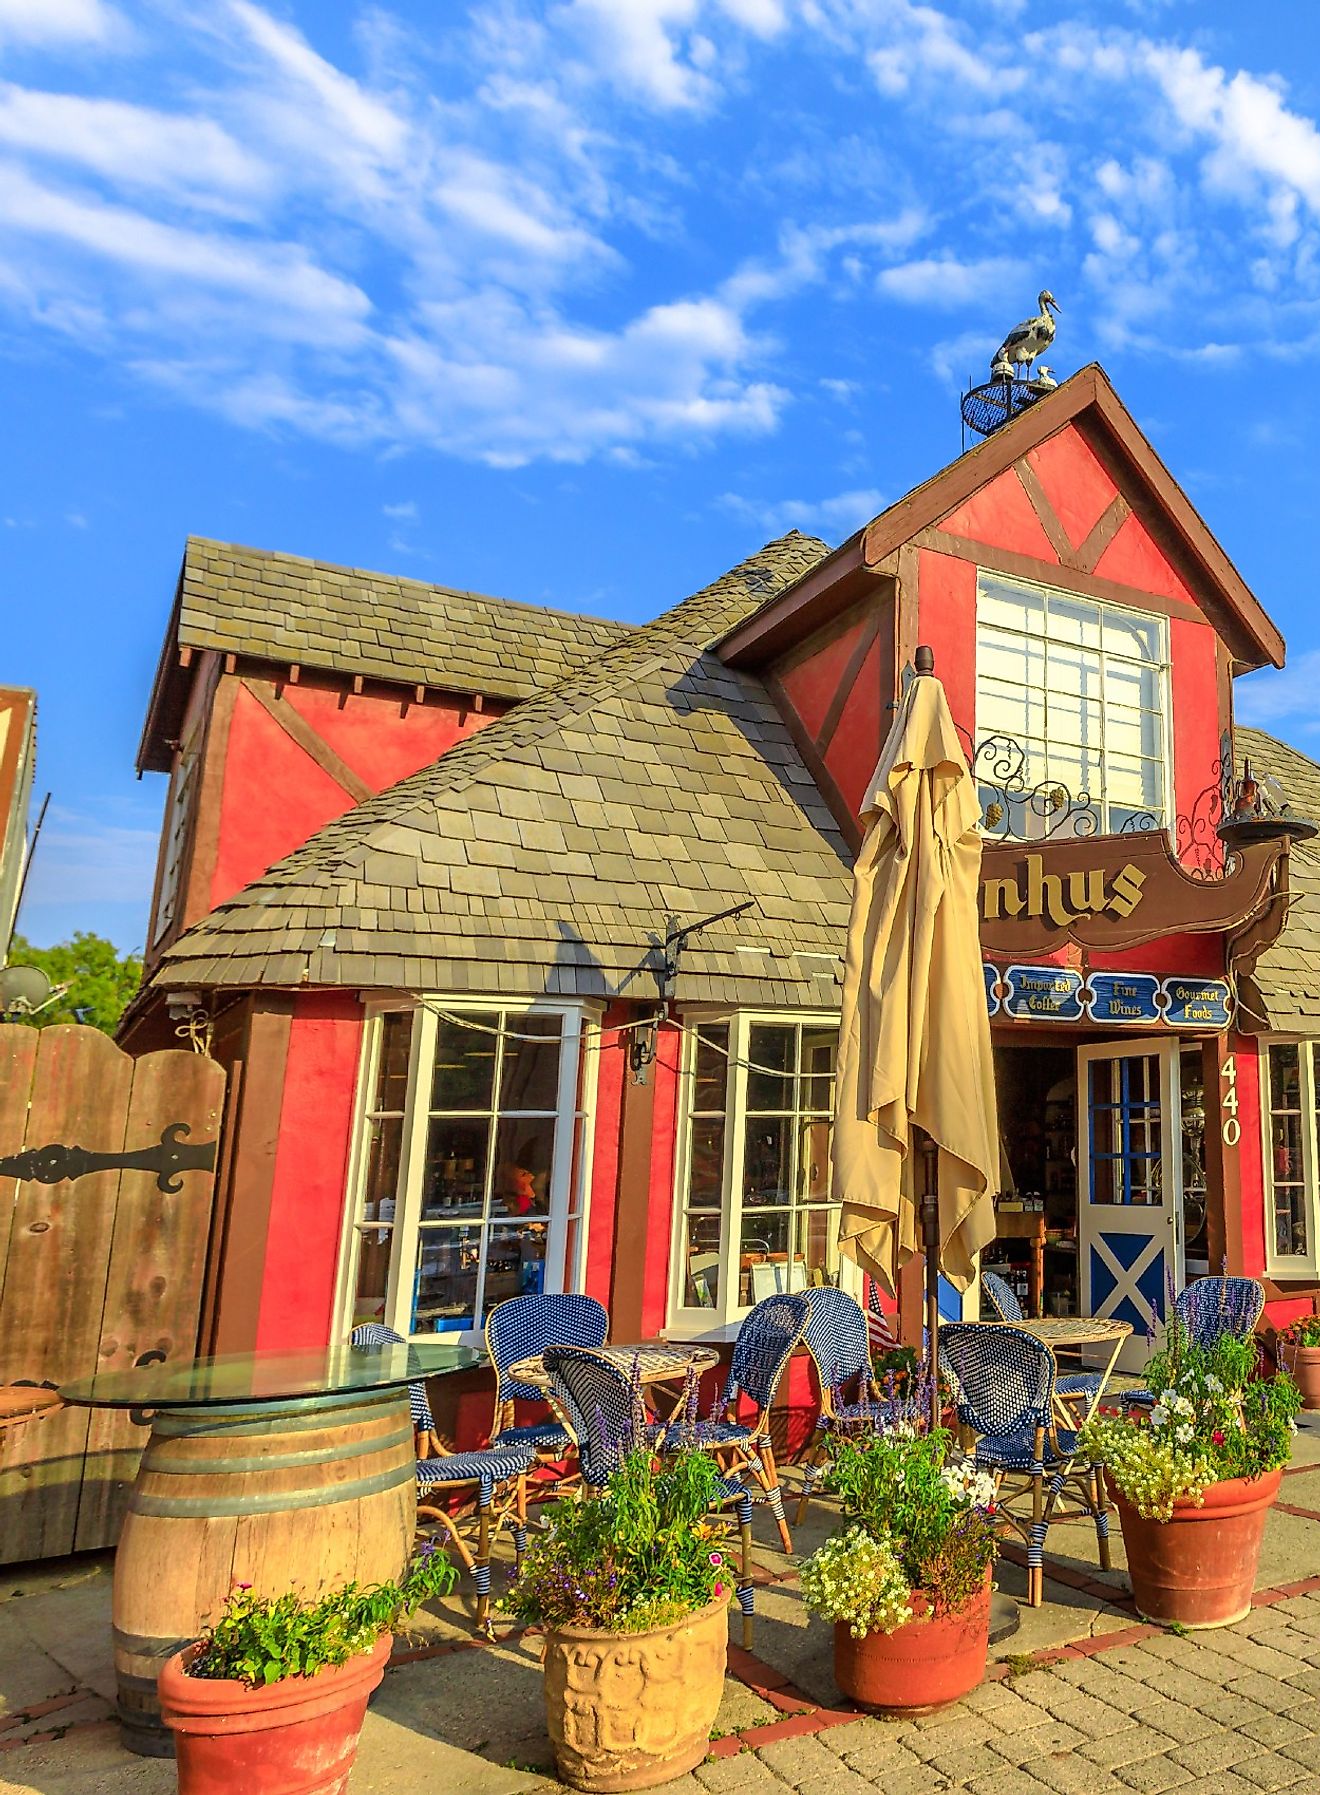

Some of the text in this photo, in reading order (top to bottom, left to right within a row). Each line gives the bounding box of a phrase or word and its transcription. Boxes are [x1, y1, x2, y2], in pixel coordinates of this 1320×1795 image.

[1020, 976, 1072, 993] Imported
[1112, 981, 1137, 997] Fine
[1176, 986, 1219, 1001] Gourmet
[1028, 995, 1061, 1012] Coffee
[1109, 1000, 1142, 1016] Wines
[1184, 1005, 1213, 1019] Foods
[1221, 1055, 1241, 1146] 440
